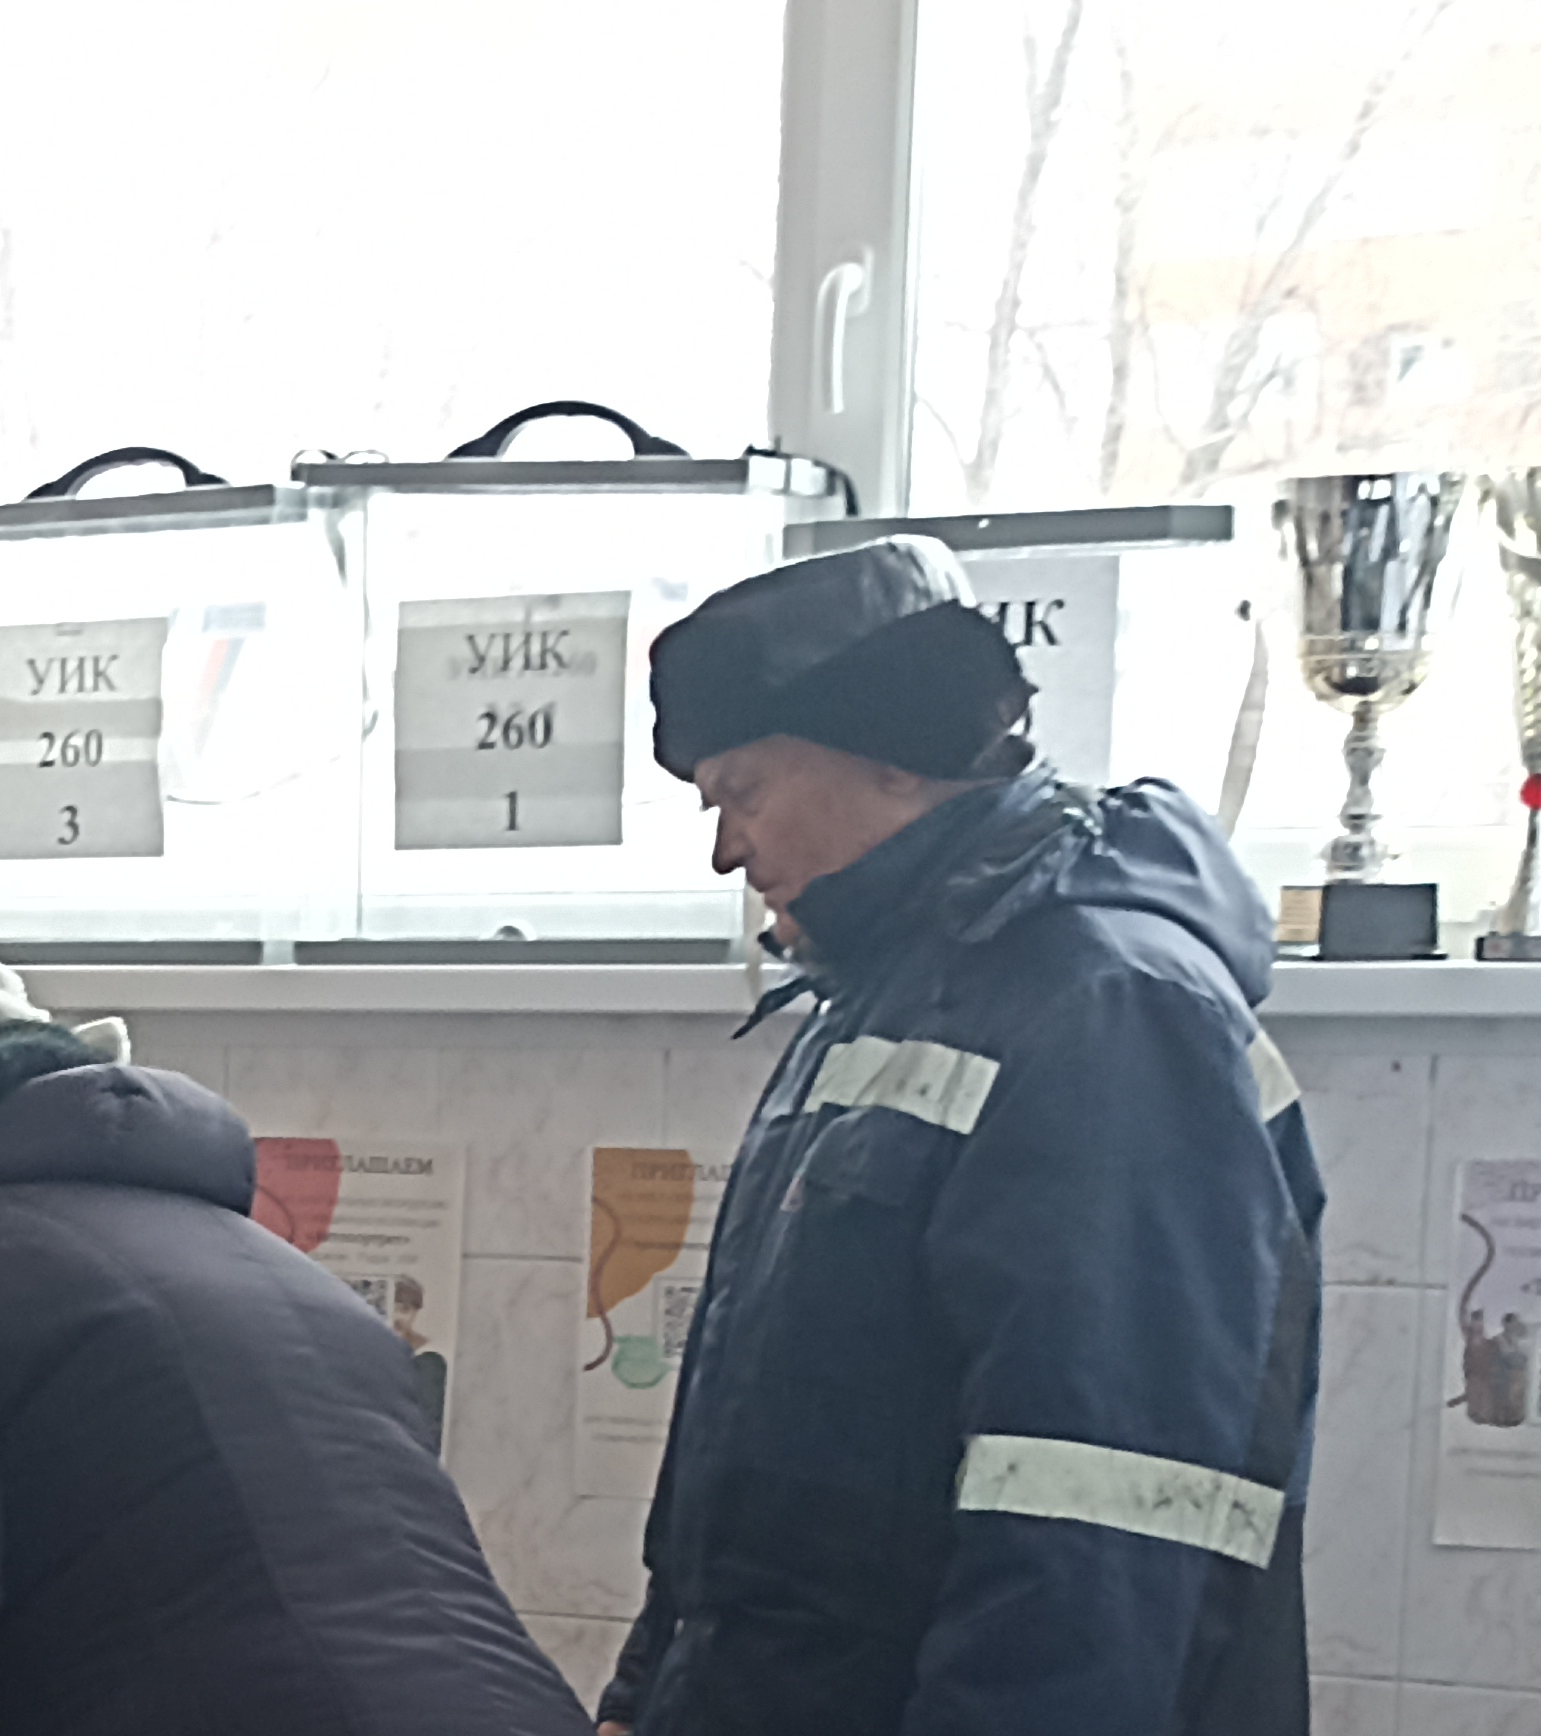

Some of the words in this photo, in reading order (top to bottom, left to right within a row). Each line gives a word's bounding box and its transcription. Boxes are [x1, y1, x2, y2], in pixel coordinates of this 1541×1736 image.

[465, 629, 571, 675] УИК
[24, 653, 120, 697] УИК
[37, 728, 104, 768] 260
[475, 708, 555, 751] 260
[56, 804, 81, 845] 3
[502, 789, 520, 832] 1
